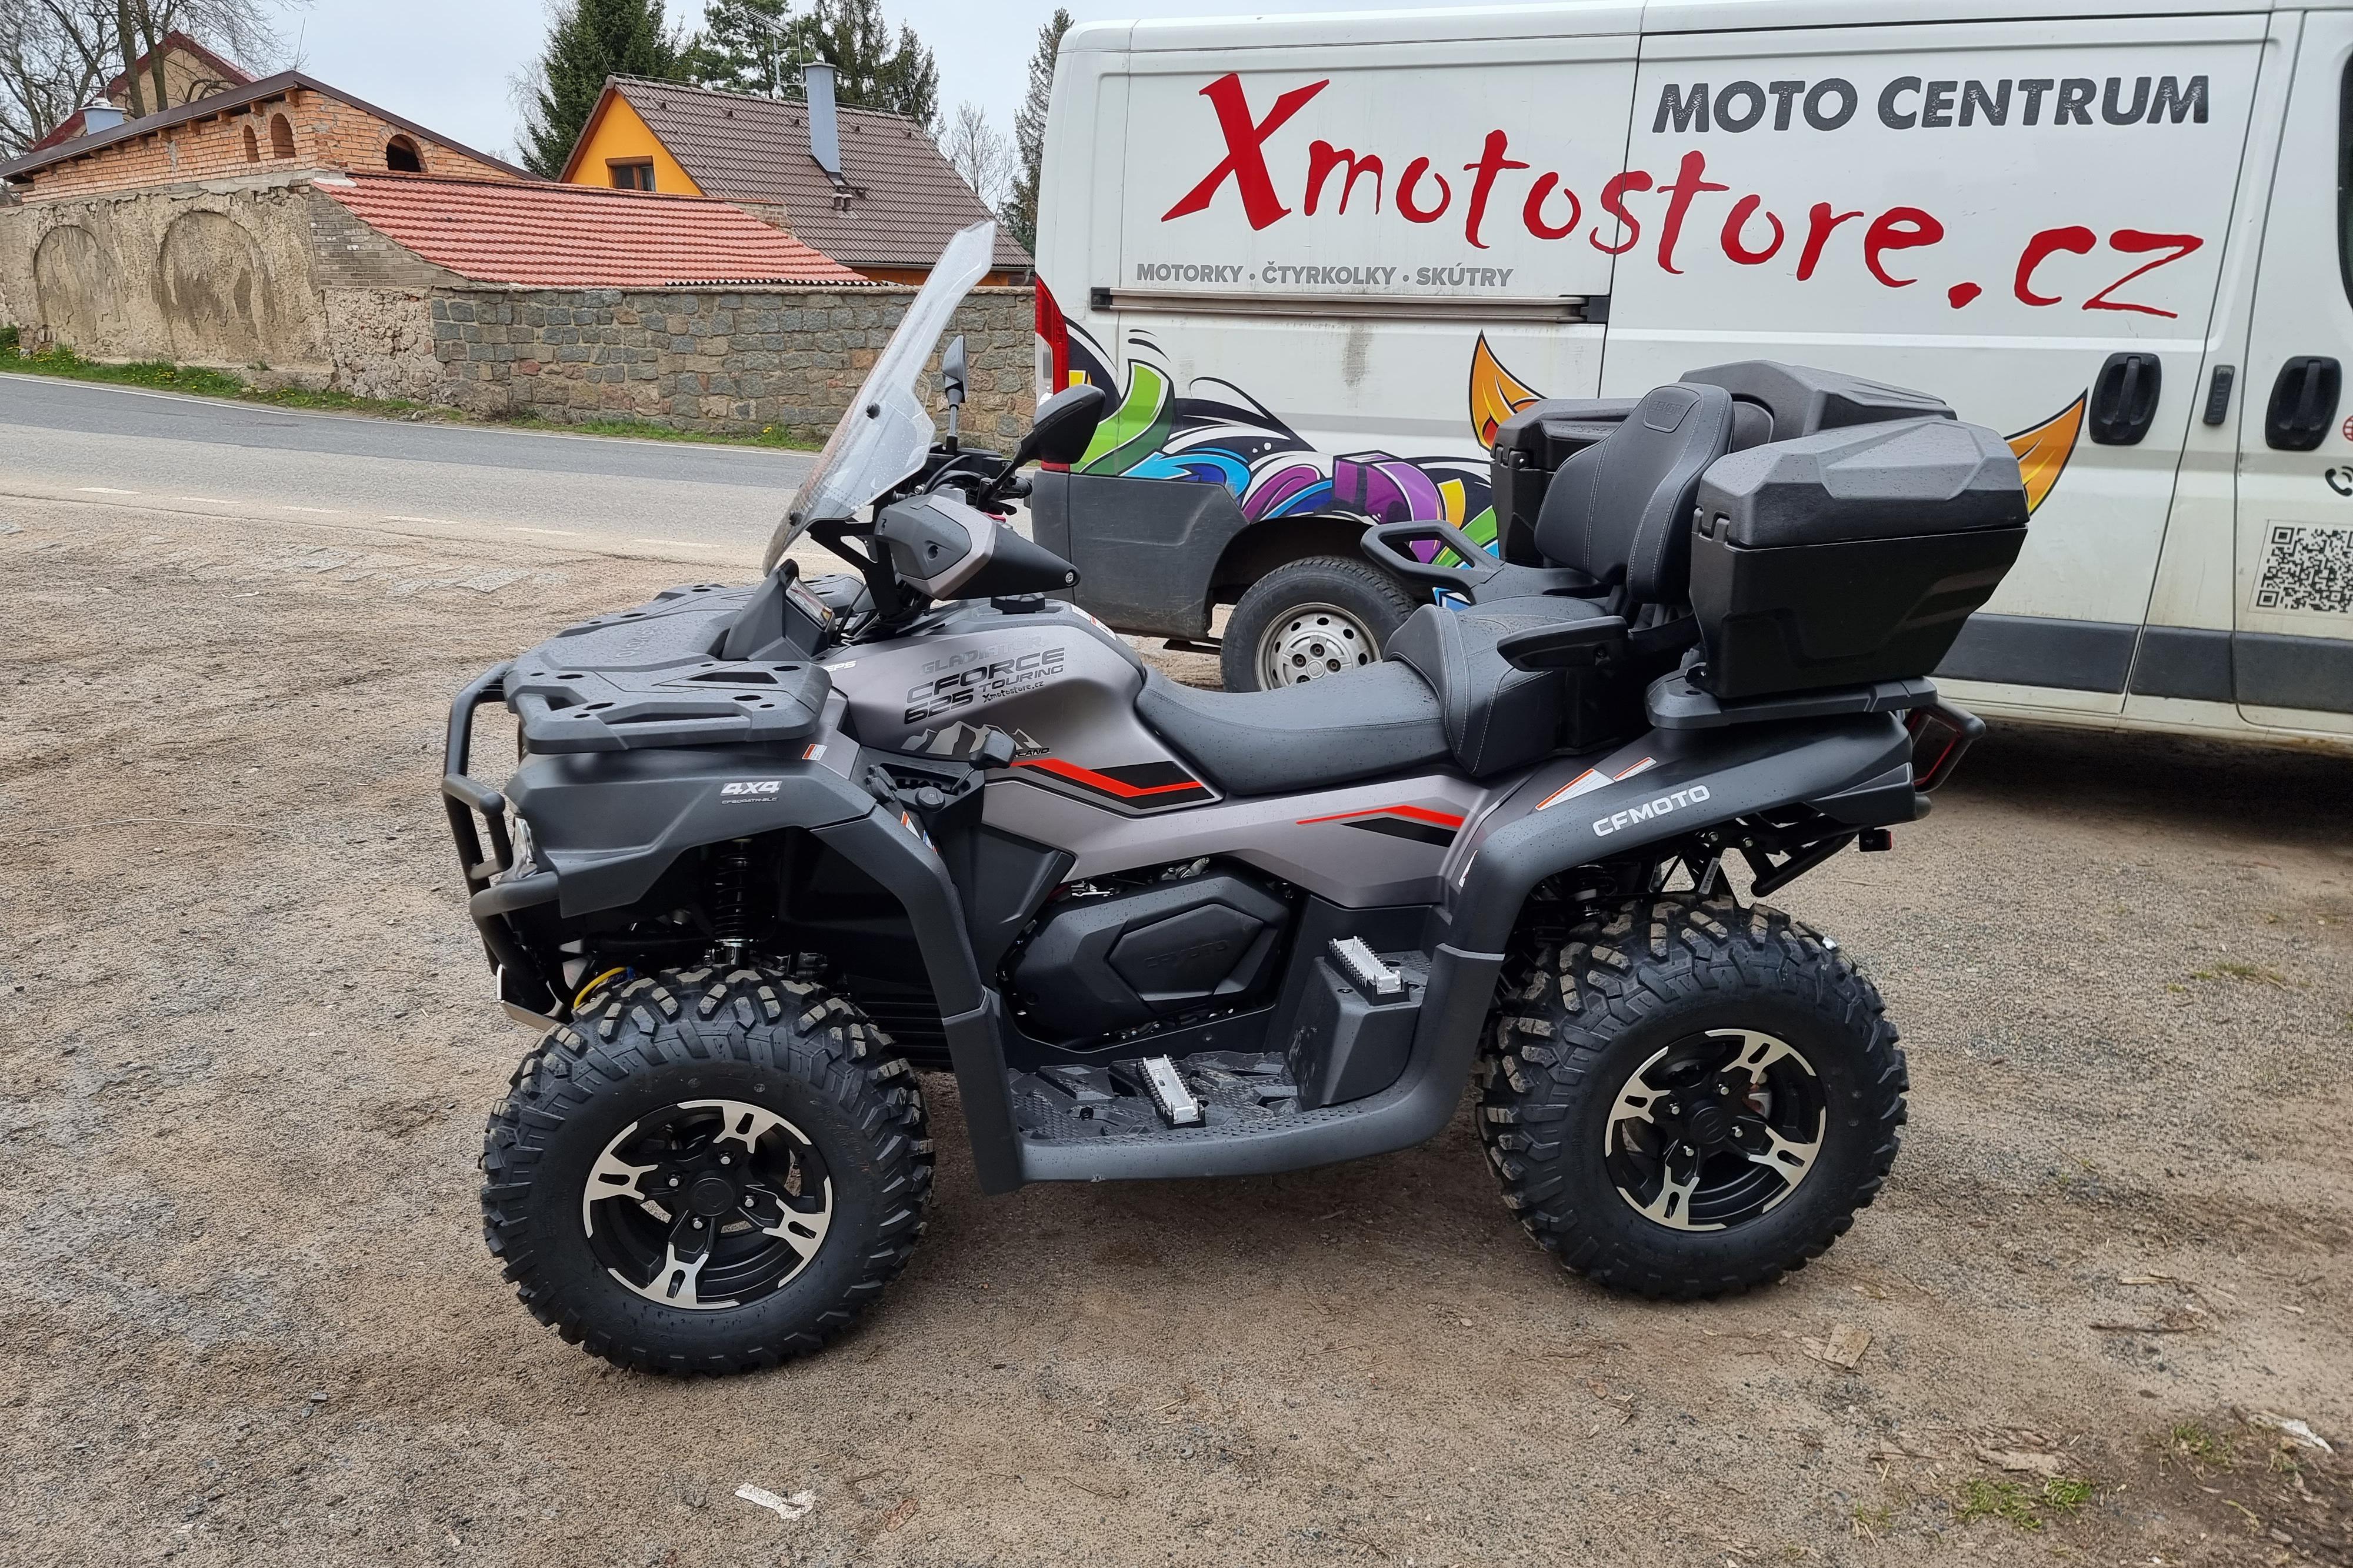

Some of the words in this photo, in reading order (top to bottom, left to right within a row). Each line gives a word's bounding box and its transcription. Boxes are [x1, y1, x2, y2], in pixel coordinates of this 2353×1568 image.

[1652, 78, 1858, 134] MOTO
[1877, 75, 2209, 130] CENTRUM
[1161, 73, 2204, 318] Xmotostore.cz
[1136, 263, 1244, 283] MOTORKY
[1262, 261, 1398, 285] ČTYRKOLKY
[1415, 262, 1514, 287] SKÚTRY
[824, 660, 857, 672] EPS
[906, 648, 1065, 703] CFORCE
[982, 680, 1045, 703] Xmotostore.cz
[904, 688, 974, 725] 625
[979, 665, 1064, 692] TOURING
[1014, 748, 1050, 758] LAND
[1592, 784, 1711, 837] CFMOTO
